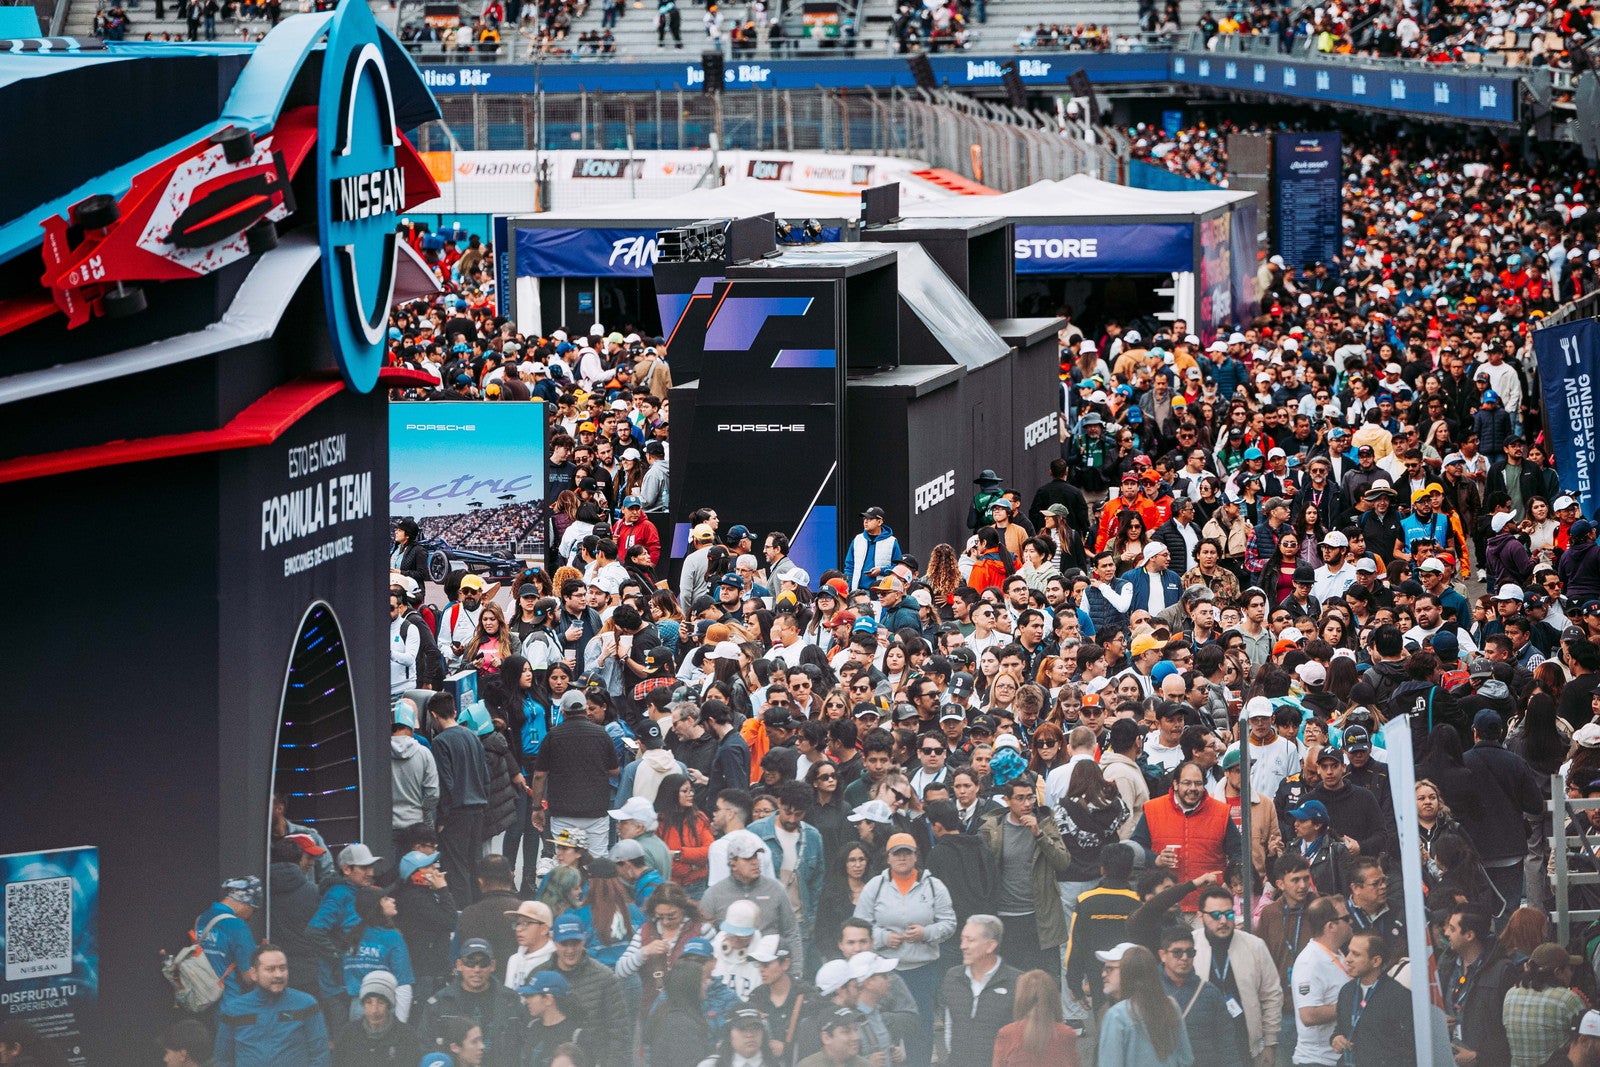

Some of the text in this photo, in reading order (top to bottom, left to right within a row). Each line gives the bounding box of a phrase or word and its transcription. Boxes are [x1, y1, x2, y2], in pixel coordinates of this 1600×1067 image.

[460, 68, 491, 86] Bär
[686, 64, 771, 86] Jus Bär
[1018, 59, 1051, 77] Bär
[340, 166, 406, 223] NISSAN
[608, 235, 665, 269] FAN
[1014, 238, 1098, 259] STORE
[88, 254, 105, 280] 23
[717, 424, 805, 432] PORSCHE
[1024, 411, 1058, 450] PORSCHE
[1578, 373, 1596, 463] CATERING
[1563, 377, 1592, 505] TEAM & CREW
[288, 433, 346, 479] ESTO ES NISSAN
[389, 474, 532, 503] lectric
[914, 469, 955, 515] PORSCHE
[261, 471, 372, 551] FORMULA E TEAM
[284, 549, 314, 577] EMOCIONES
[321, 541, 335, 563] ALTO
[20, 964, 58, 974] NISSAN
[1, 984, 77, 1005] DISFRUTA TU
[9, 998, 69, 1014] EXPERIENCIA
